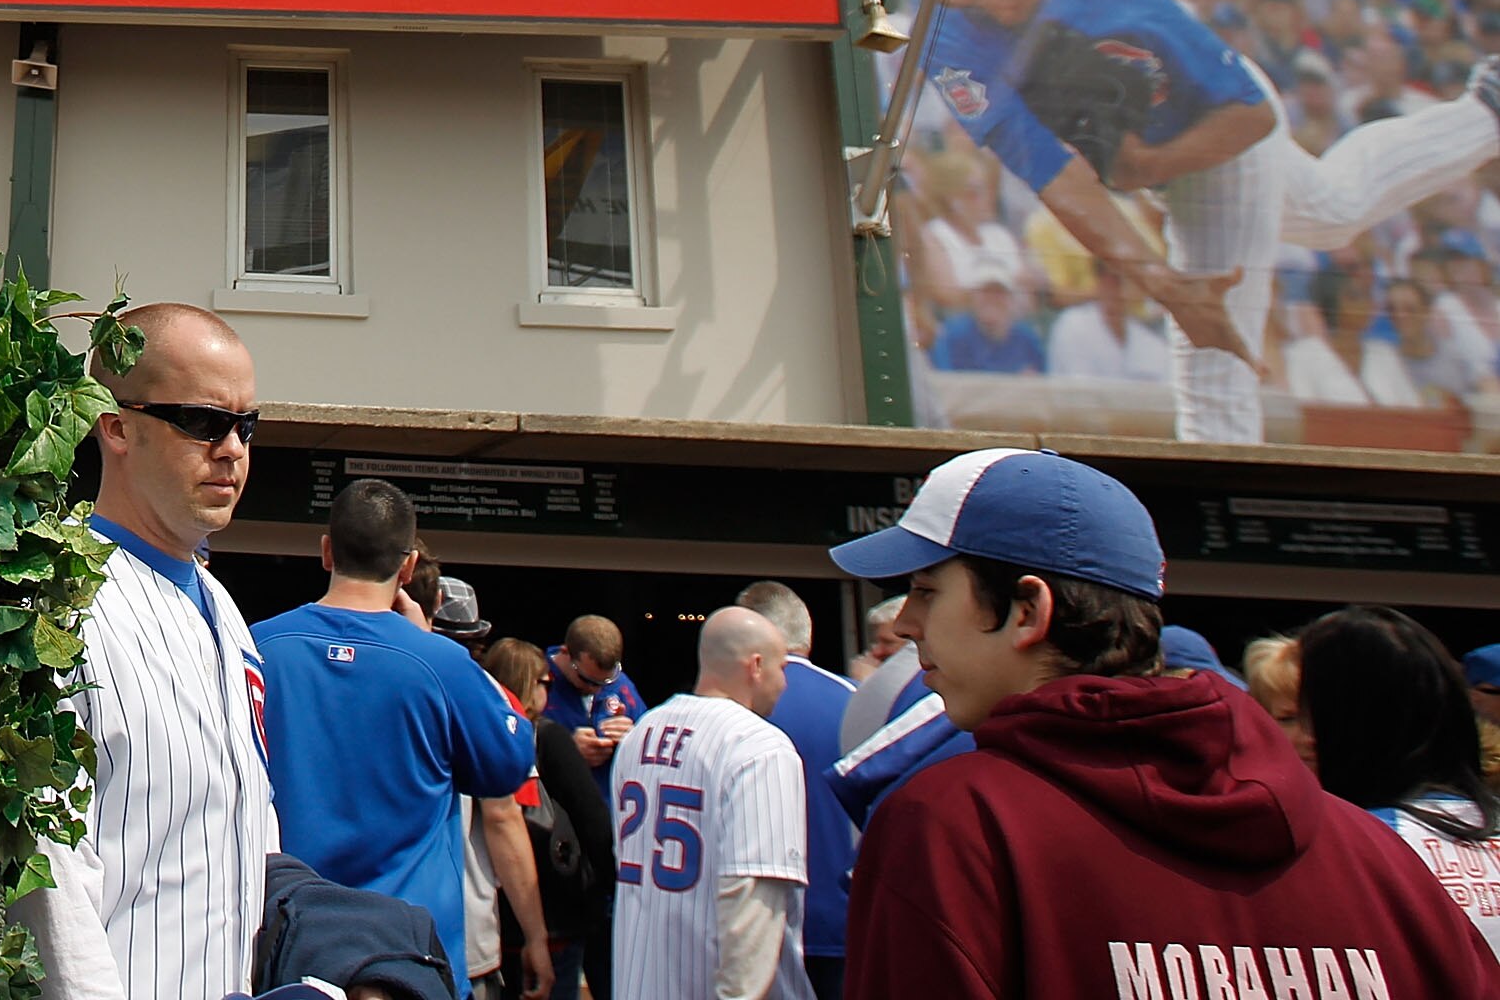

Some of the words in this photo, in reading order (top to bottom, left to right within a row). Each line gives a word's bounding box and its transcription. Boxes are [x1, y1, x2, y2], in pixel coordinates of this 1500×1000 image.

[366, 463, 413, 474] FOLLOWING
[415, 465, 440, 475] ITEMS
[641, 726, 694, 768] LEE
[617, 780, 705, 893] 25
[1108, 941, 1390, 1000] MORAHAN
